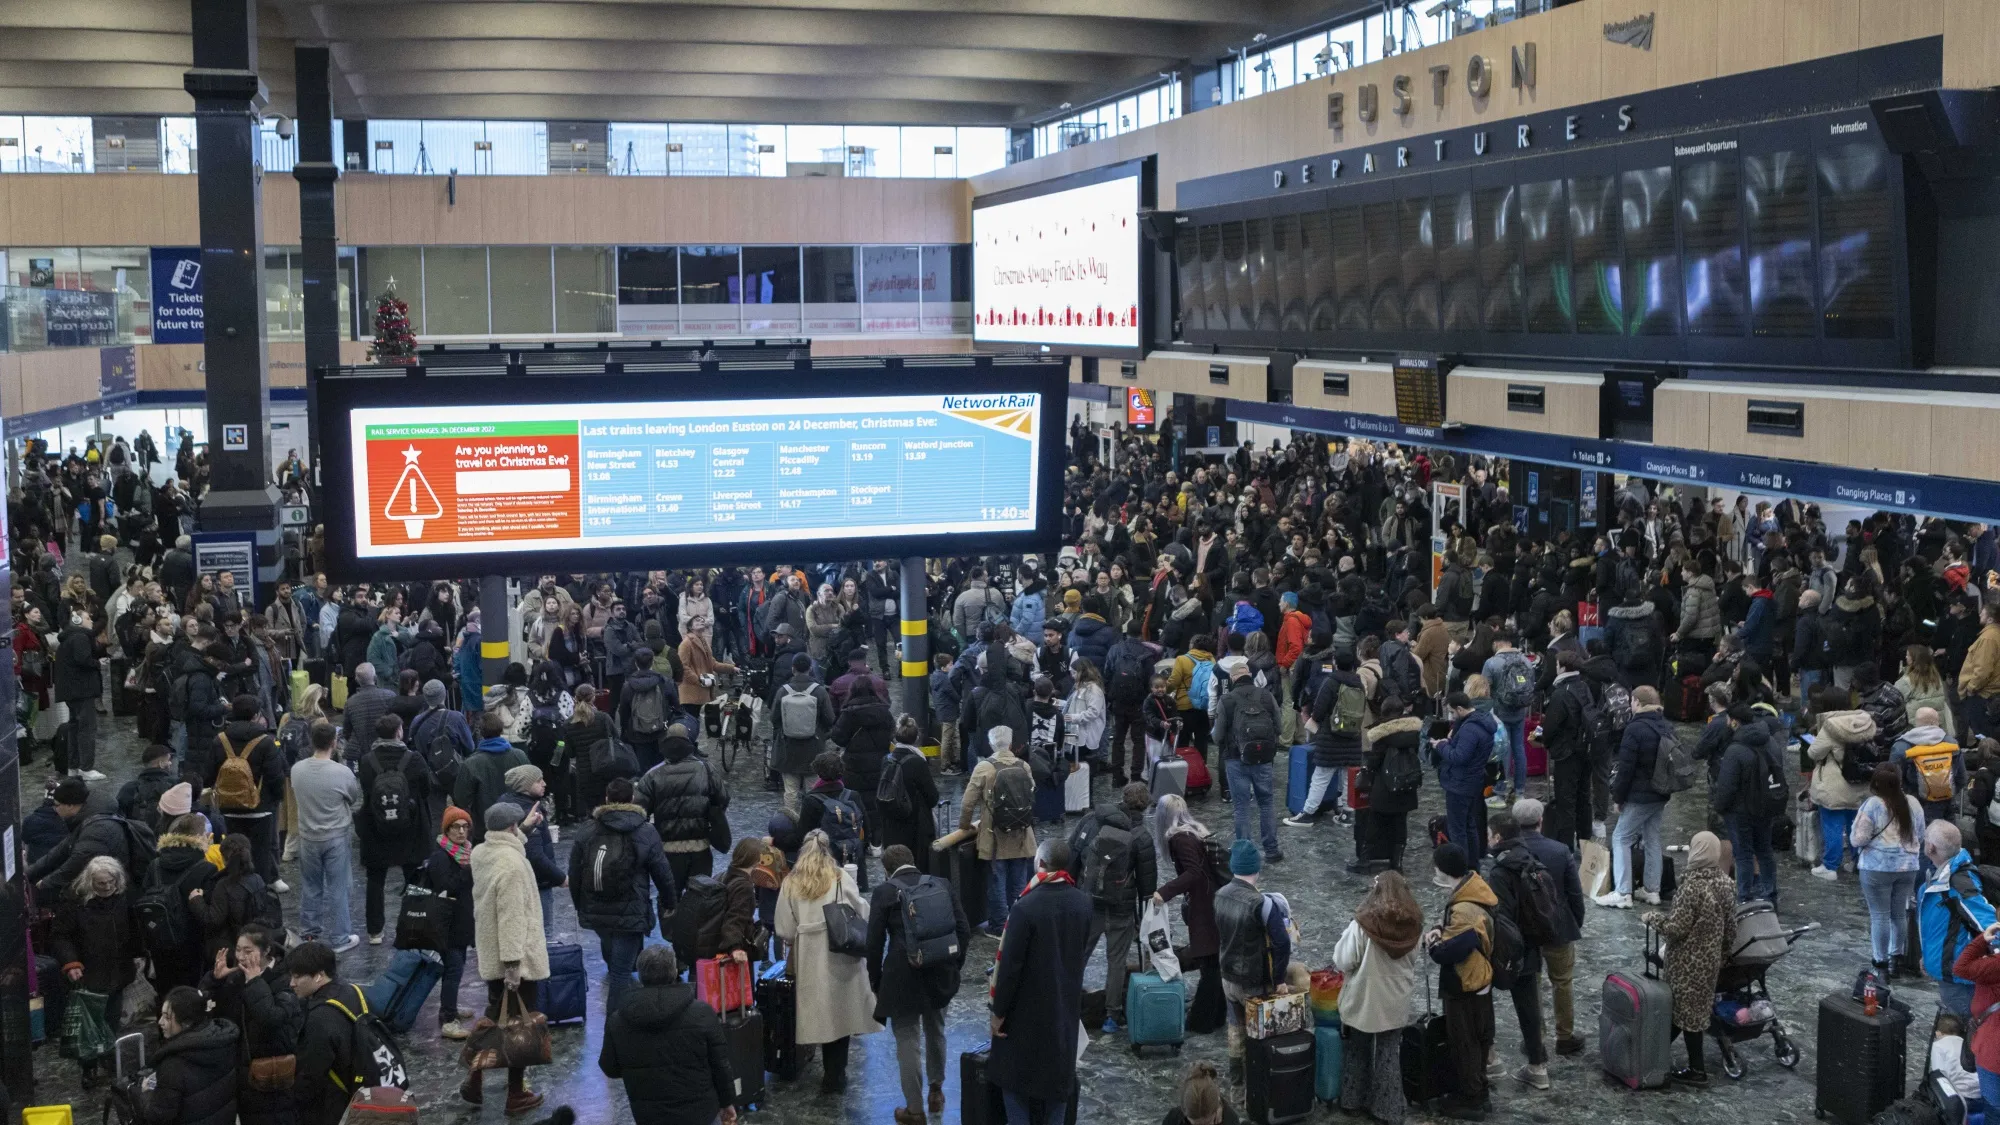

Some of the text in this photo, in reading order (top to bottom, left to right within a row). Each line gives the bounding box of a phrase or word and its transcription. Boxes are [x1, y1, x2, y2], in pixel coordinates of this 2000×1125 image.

[1327, 41, 1537, 129] EUSTON
[1830, 121, 1868, 134] Information
[1273, 104, 1635, 189] DEPARTURES
[1674, 139, 1738, 156] Subsequent Departures
[1054, 259, 1075, 282] Finds
[1088, 256, 1108, 285] Way
[168, 292, 203, 303] Tickets
[158, 305, 204, 318] for today
[156, 319, 188, 330] future
[1399, 359, 1428, 368] ARRIVALS ONLY
[943, 394, 1036, 409] NetworkRail
[386, 427, 409, 435] SERVICE
[449, 426, 480, 434] DECEMBER
[583, 416, 938, 437] Last trains leaving London Euston on 24 December, Christmas Eve:
[1357, 419, 1378, 431] Platforms
[1423, 428, 1435, 437] ONLY
[455, 444, 548, 457] Are you planning to
[779, 444, 830, 453] Manchester
[851, 442, 887, 451] Runcorn
[904, 440, 974, 450] Watford Junction
[587, 449, 642, 460] Birmingham
[655, 448, 696, 458] Bletchley
[712, 446, 750, 457] Glasgow
[851, 453, 874, 461] 13.19
[1578, 451, 1596, 463] Toilets
[456, 454, 569, 468] travel on Christmas Eve?
[587, 461, 636, 469] New Street
[655, 459, 679, 468] 14.53
[712, 458, 745, 467] Central
[779, 455, 820, 465] Piccadilly
[713, 468, 736, 477] 12.22
[1646, 462, 1688, 475] Changing Places
[1748, 473, 1771, 486] Toilets
[712, 490, 753, 500] Liverpool
[779, 488, 838, 497] Northampton
[850, 485, 891, 494] Stockport
[1836, 485, 1893, 501] Changing Places
[587, 494, 642, 504] Birmingham
[655, 493, 683, 501] Crewe
[587, 504, 647, 515] International
[712, 501, 761, 511] Lime Street
[981, 507, 1018, 520] 11:40
